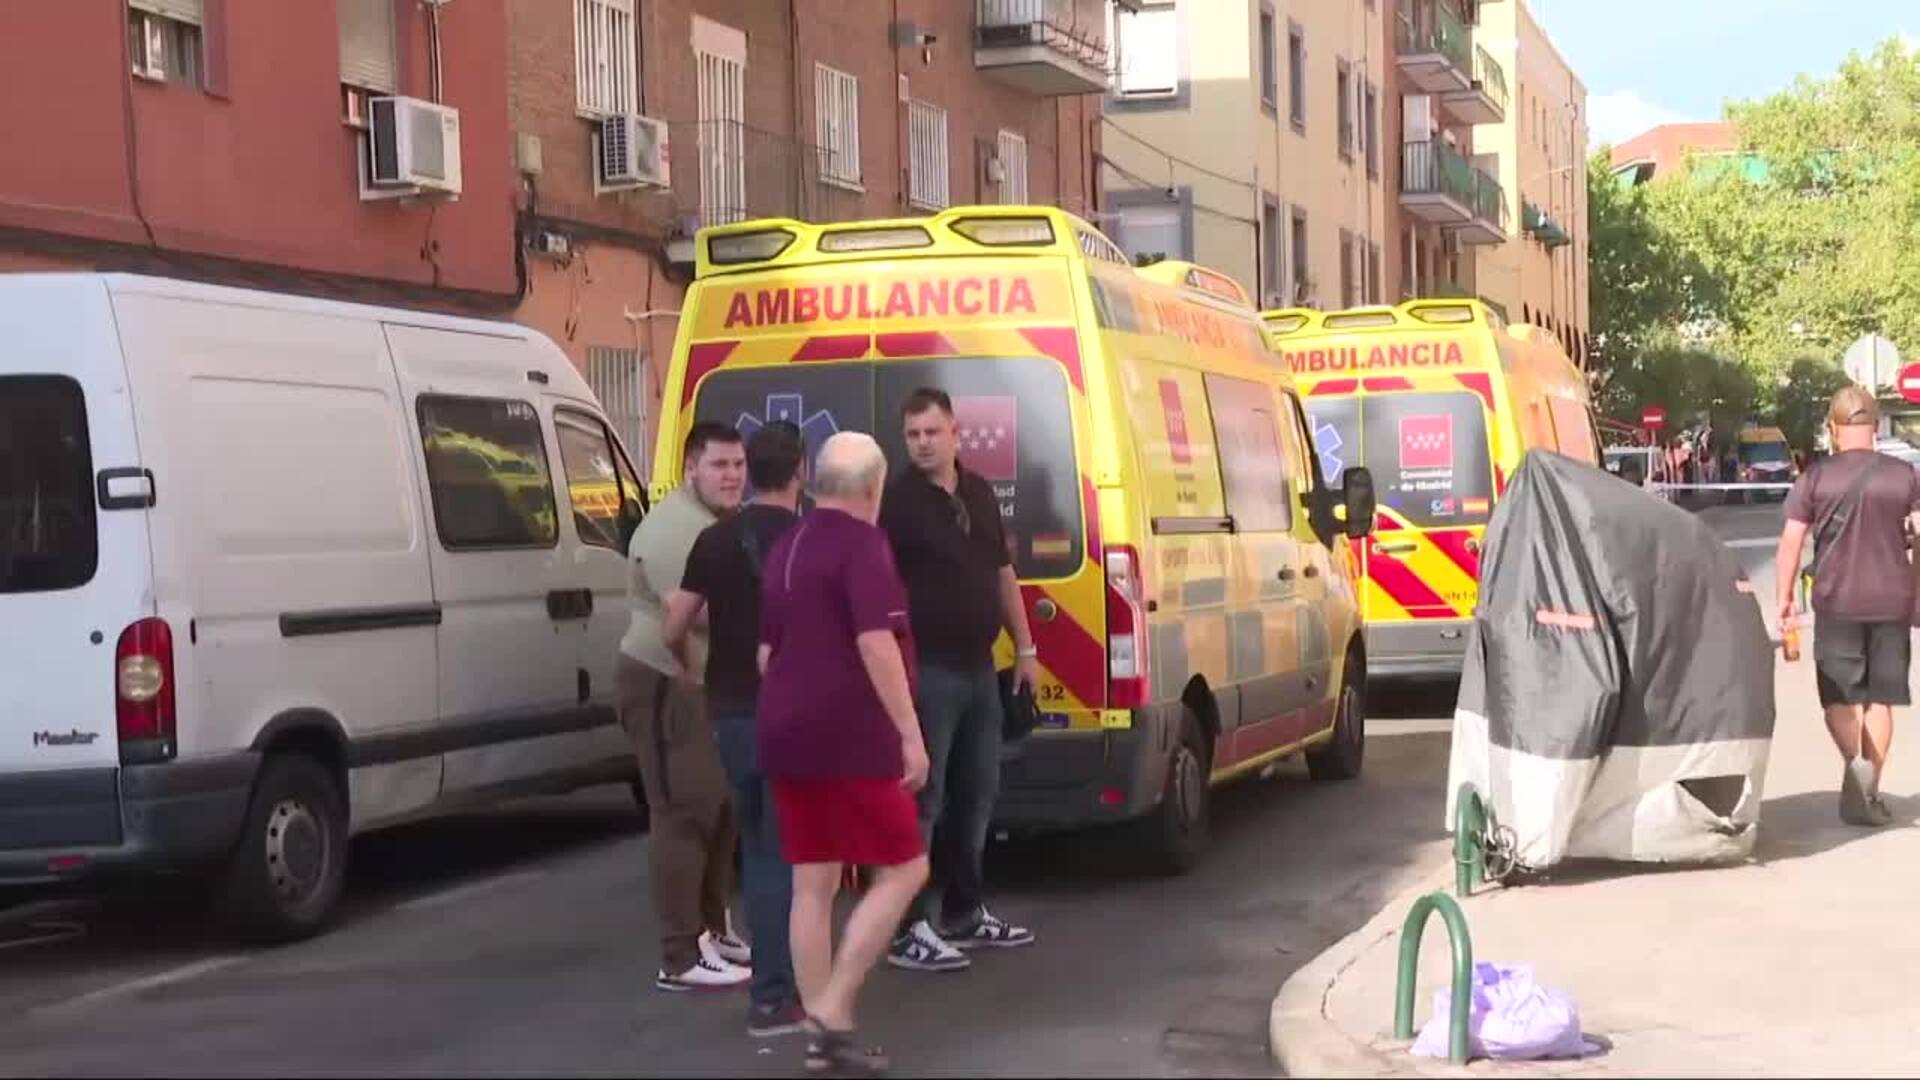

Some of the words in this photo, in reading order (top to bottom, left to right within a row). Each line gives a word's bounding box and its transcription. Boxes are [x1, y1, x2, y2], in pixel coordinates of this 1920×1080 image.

[724, 276, 1037, 329] AMBULANCIA
[1284, 342, 1464, 374] MBULANCIA
[1041, 684, 1065, 701] 32
